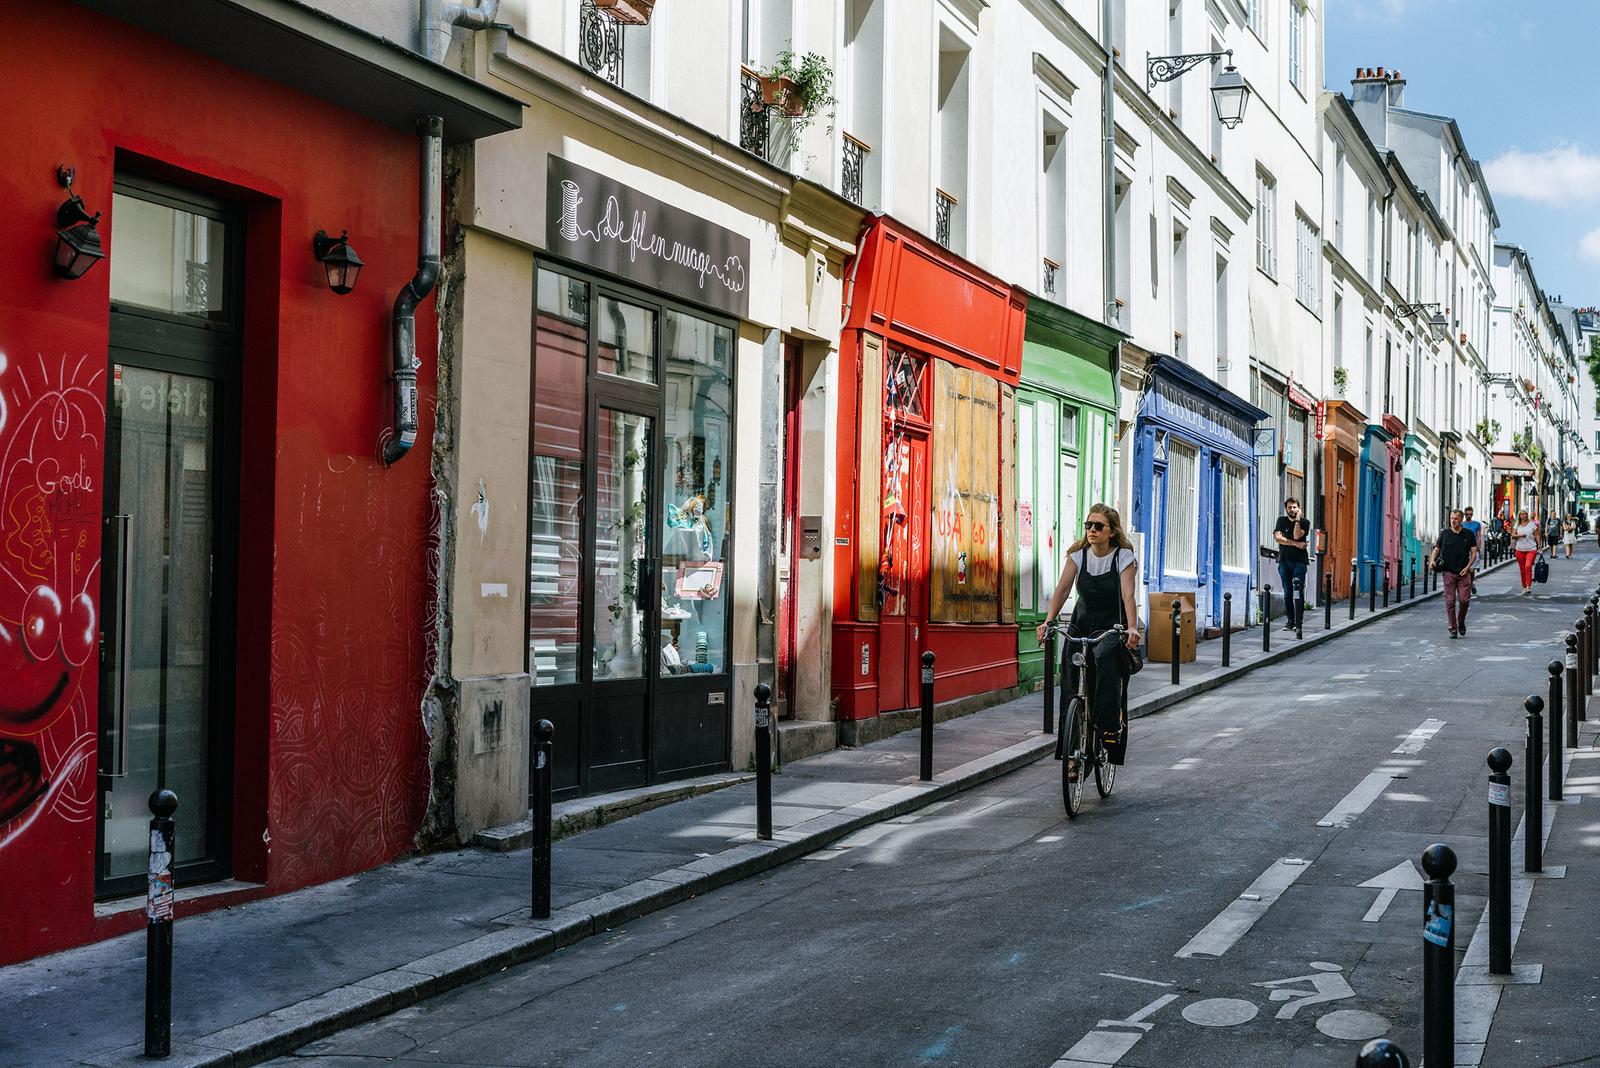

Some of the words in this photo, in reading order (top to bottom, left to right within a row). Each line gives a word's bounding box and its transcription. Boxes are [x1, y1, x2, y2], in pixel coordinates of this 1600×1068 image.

[603, 195, 628, 241] De
[650, 233, 667, 258] en
[672, 241, 711, 289] nuage
[937, 510, 962, 542] USA
[972, 522, 985, 545] GO
